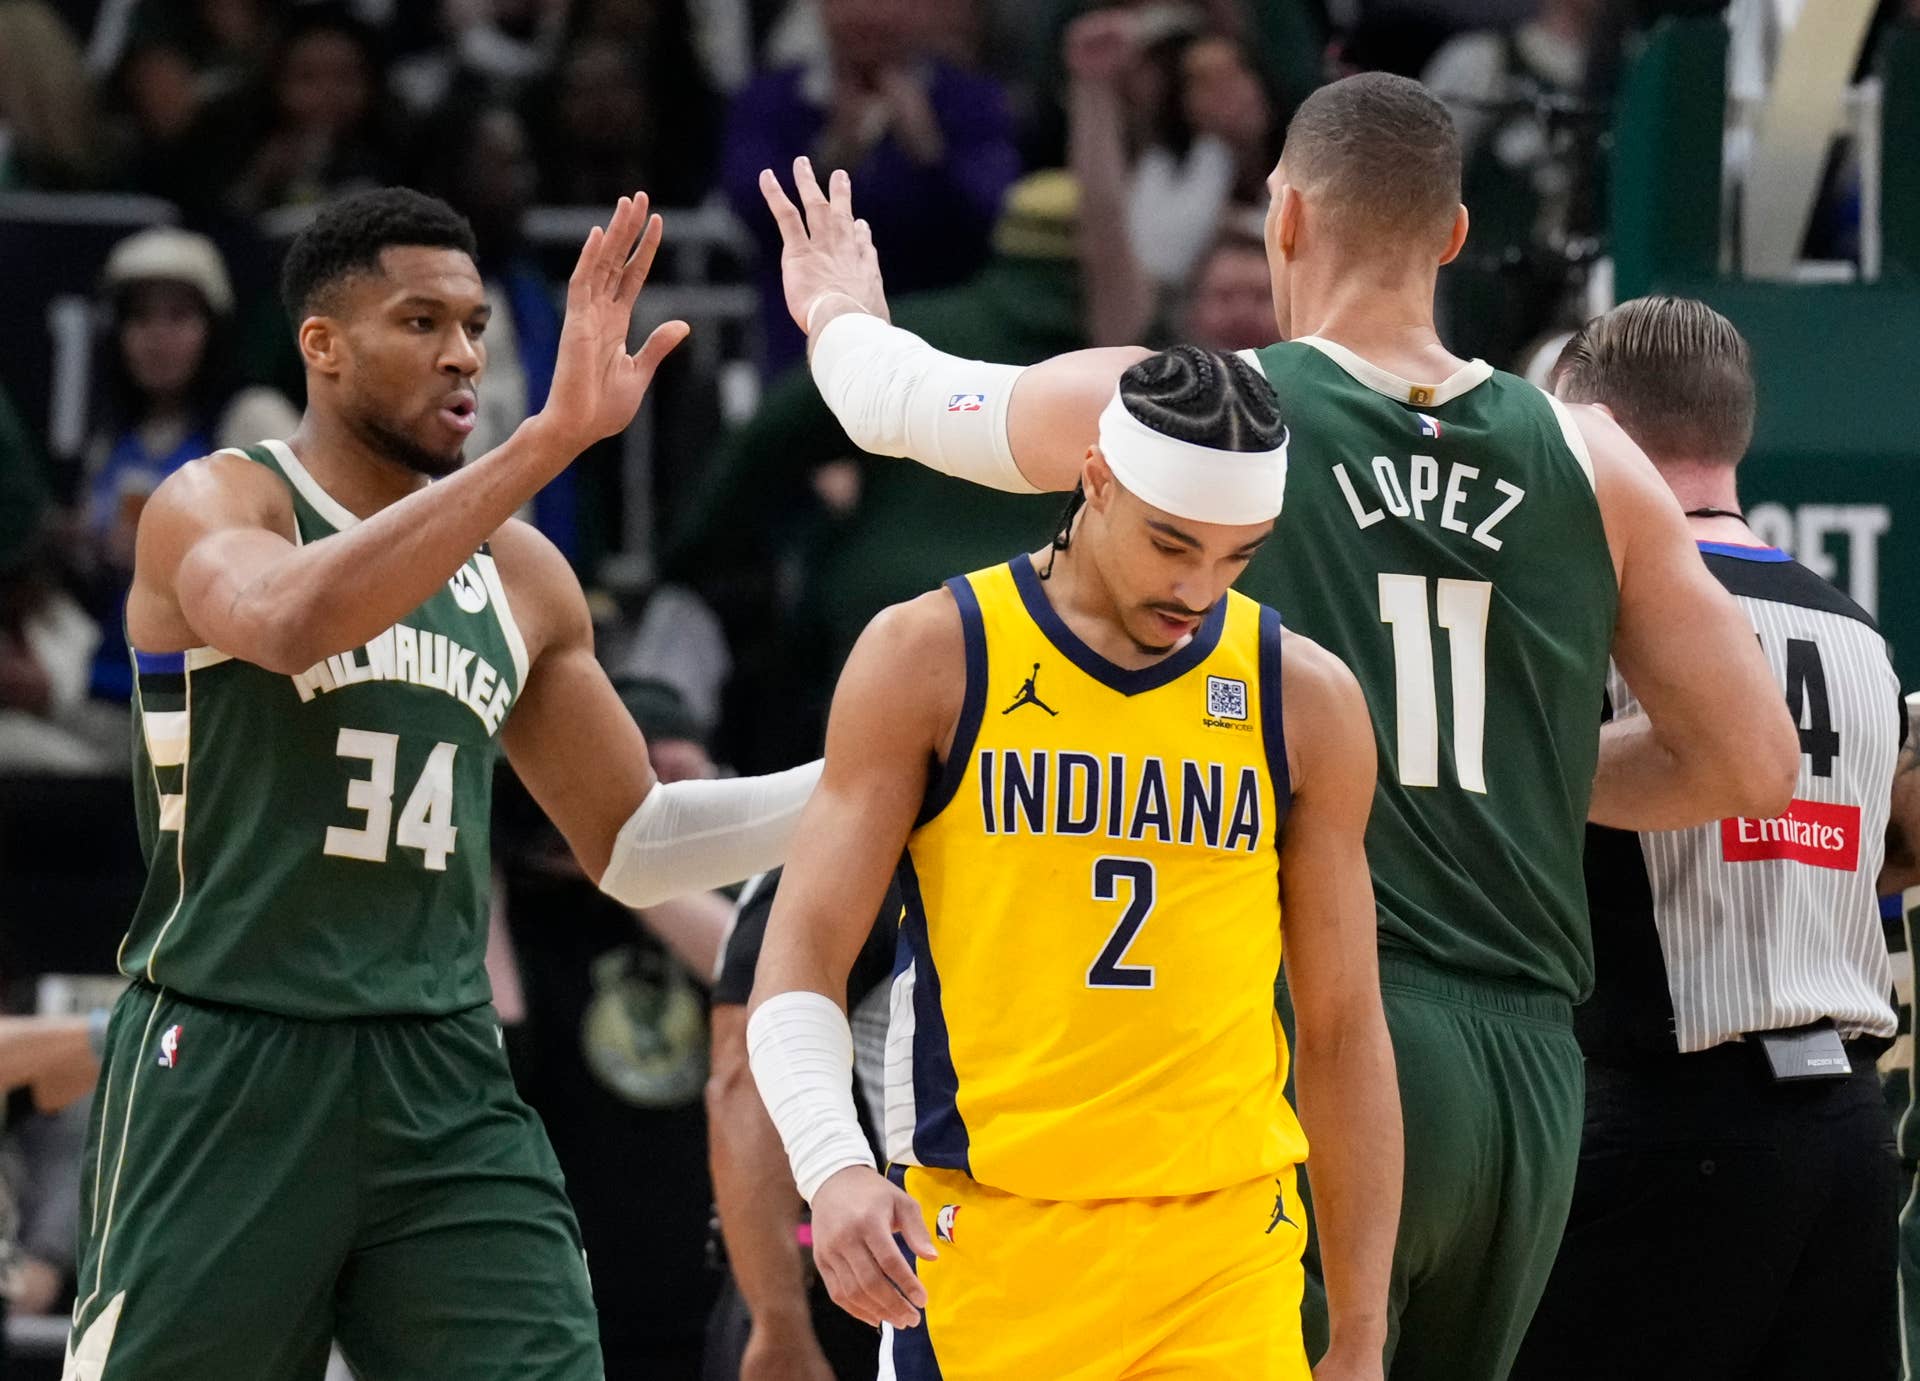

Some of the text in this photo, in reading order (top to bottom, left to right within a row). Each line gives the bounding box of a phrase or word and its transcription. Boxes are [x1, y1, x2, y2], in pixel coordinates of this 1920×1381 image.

[1332, 455, 1525, 551] LOPEZ
[1202, 718, 1254, 732] spokenote
[1377, 573, 1493, 795] 11
[323, 727, 459, 871] 34
[979, 748, 1263, 853] INDIANA
[1736, 812, 1845, 852] Emirates
[1085, 854, 1157, 990] 2
